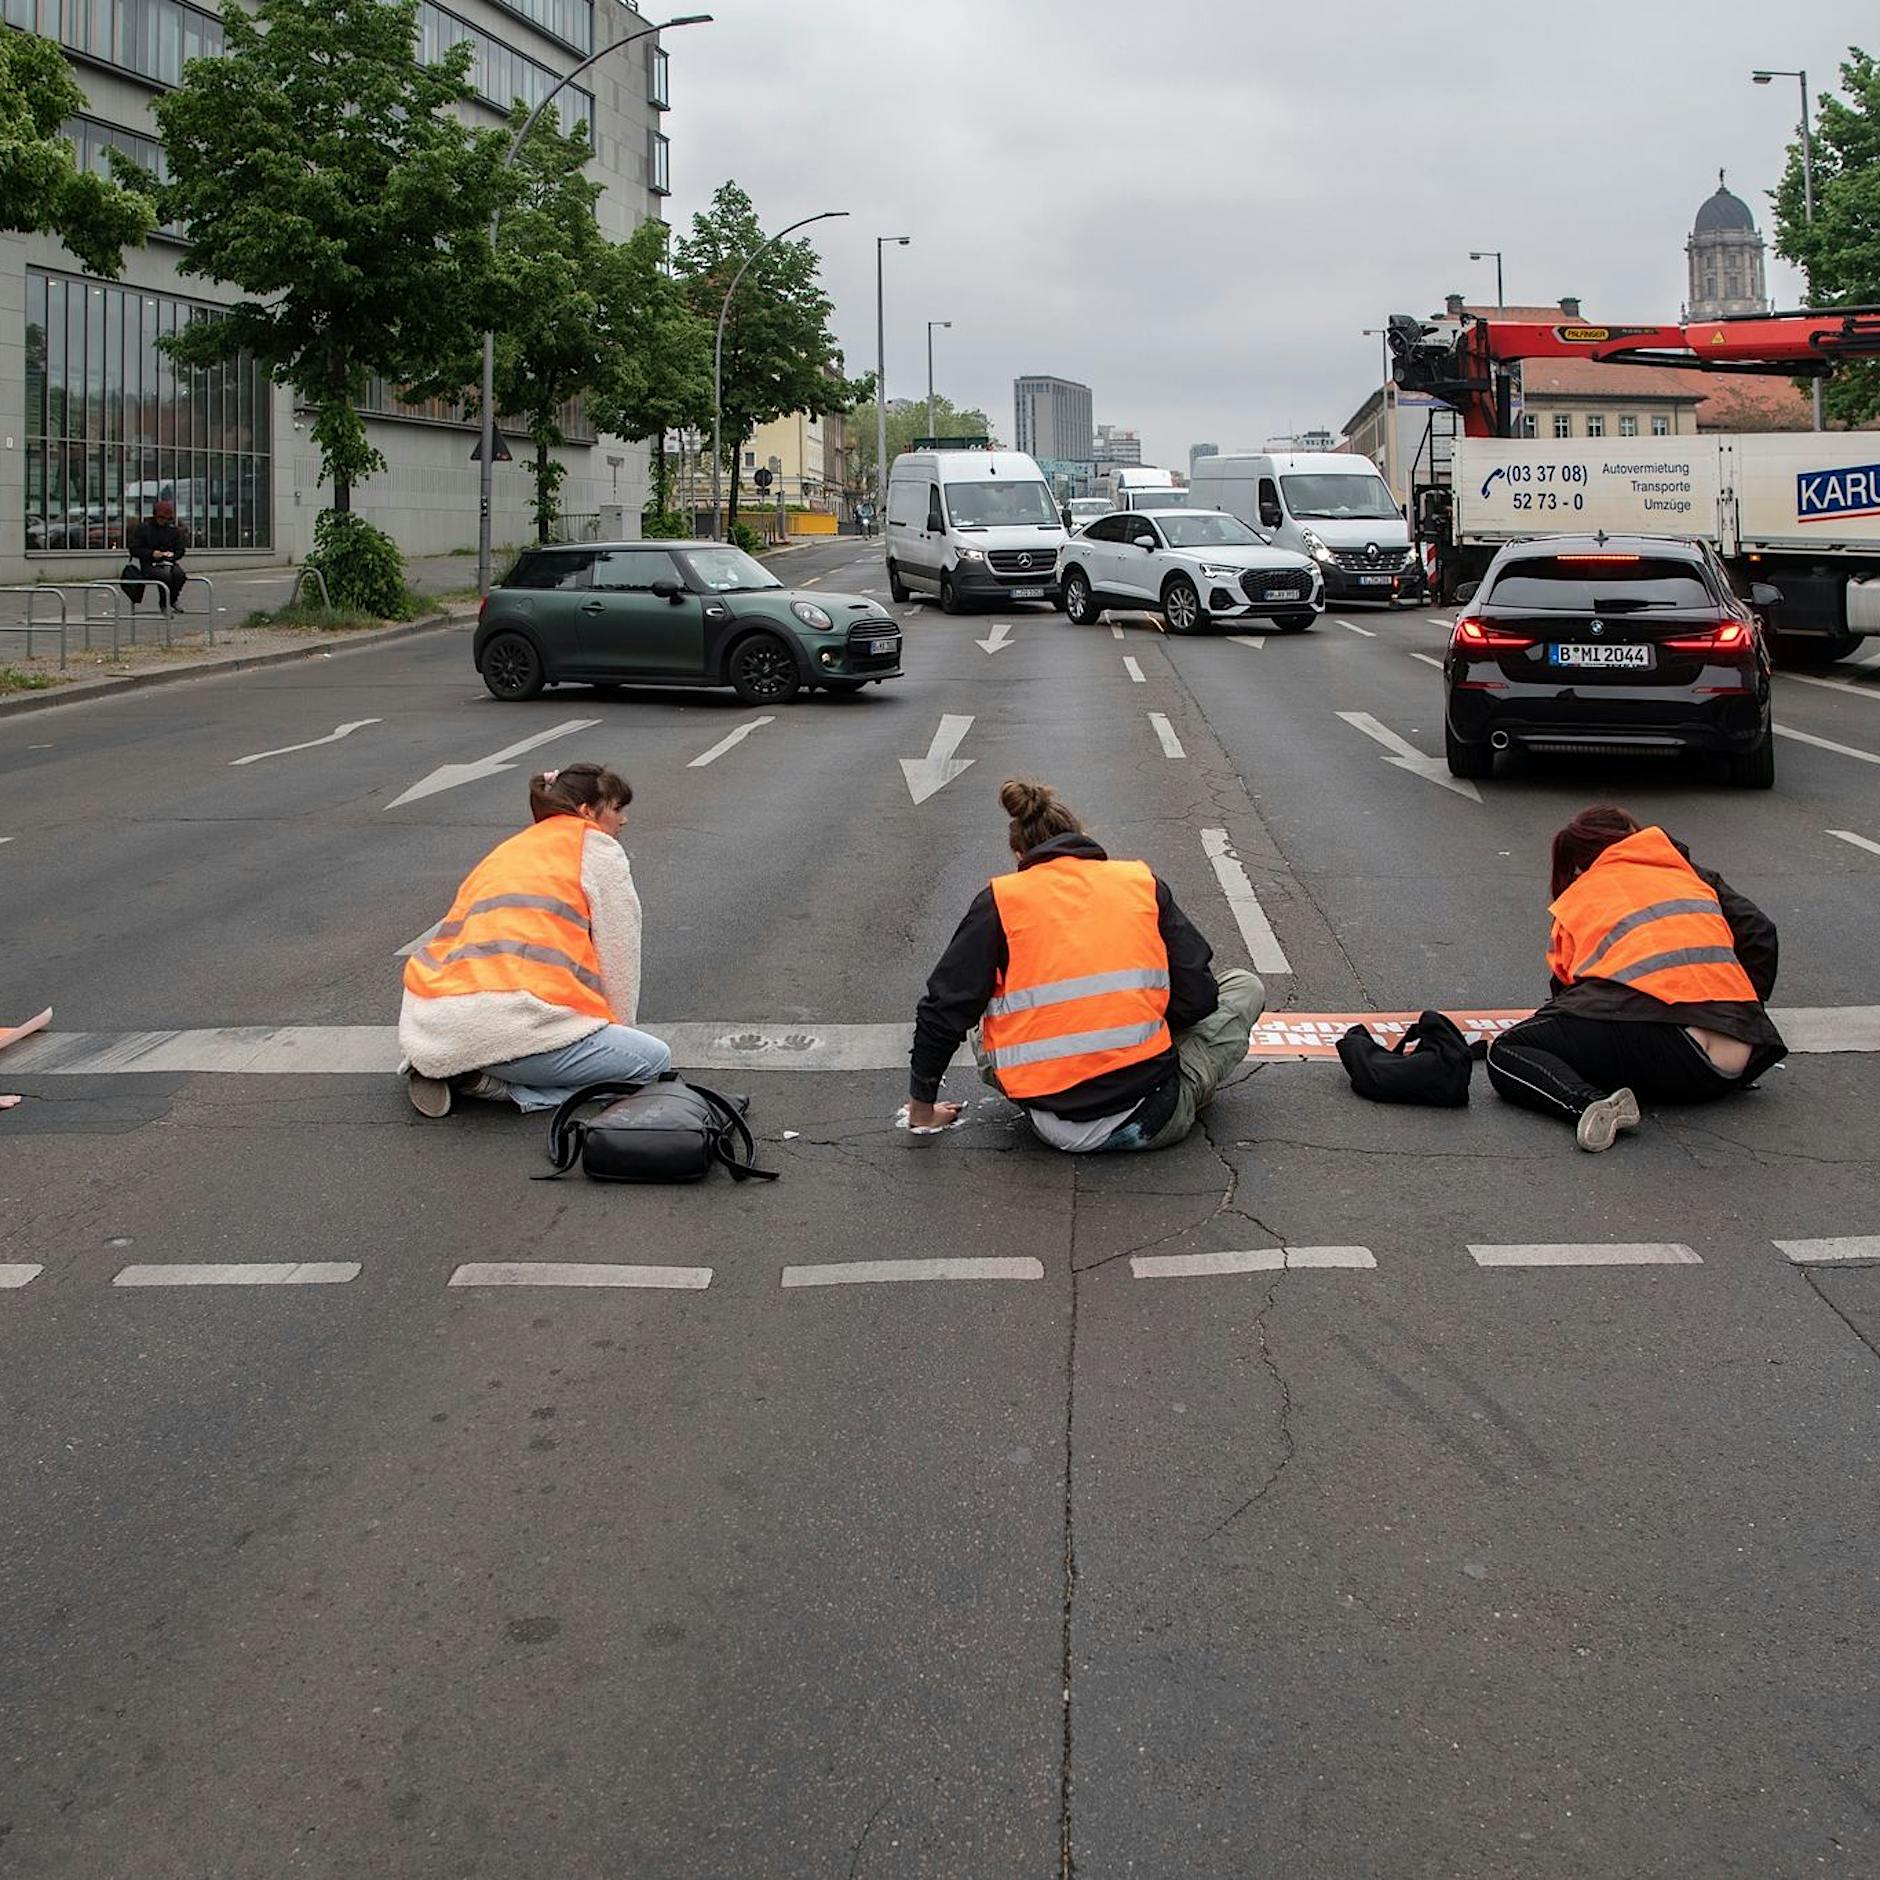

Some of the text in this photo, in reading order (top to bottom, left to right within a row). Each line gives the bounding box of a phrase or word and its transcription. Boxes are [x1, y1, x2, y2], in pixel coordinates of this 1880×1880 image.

[1507, 465, 1587, 486] (03 37 08)
[1602, 463, 1689, 476] Autovermietung
[1631, 480, 1691, 494] Transporte
[1513, 493, 1532, 509] 52
[1537, 493, 1557, 509] 73
[1574, 493, 1583, 510] 0
[1644, 498, 1691, 513] Umzüge
[1560, 647, 1571, 661] B
[1604, 647, 1644, 663] 2044
